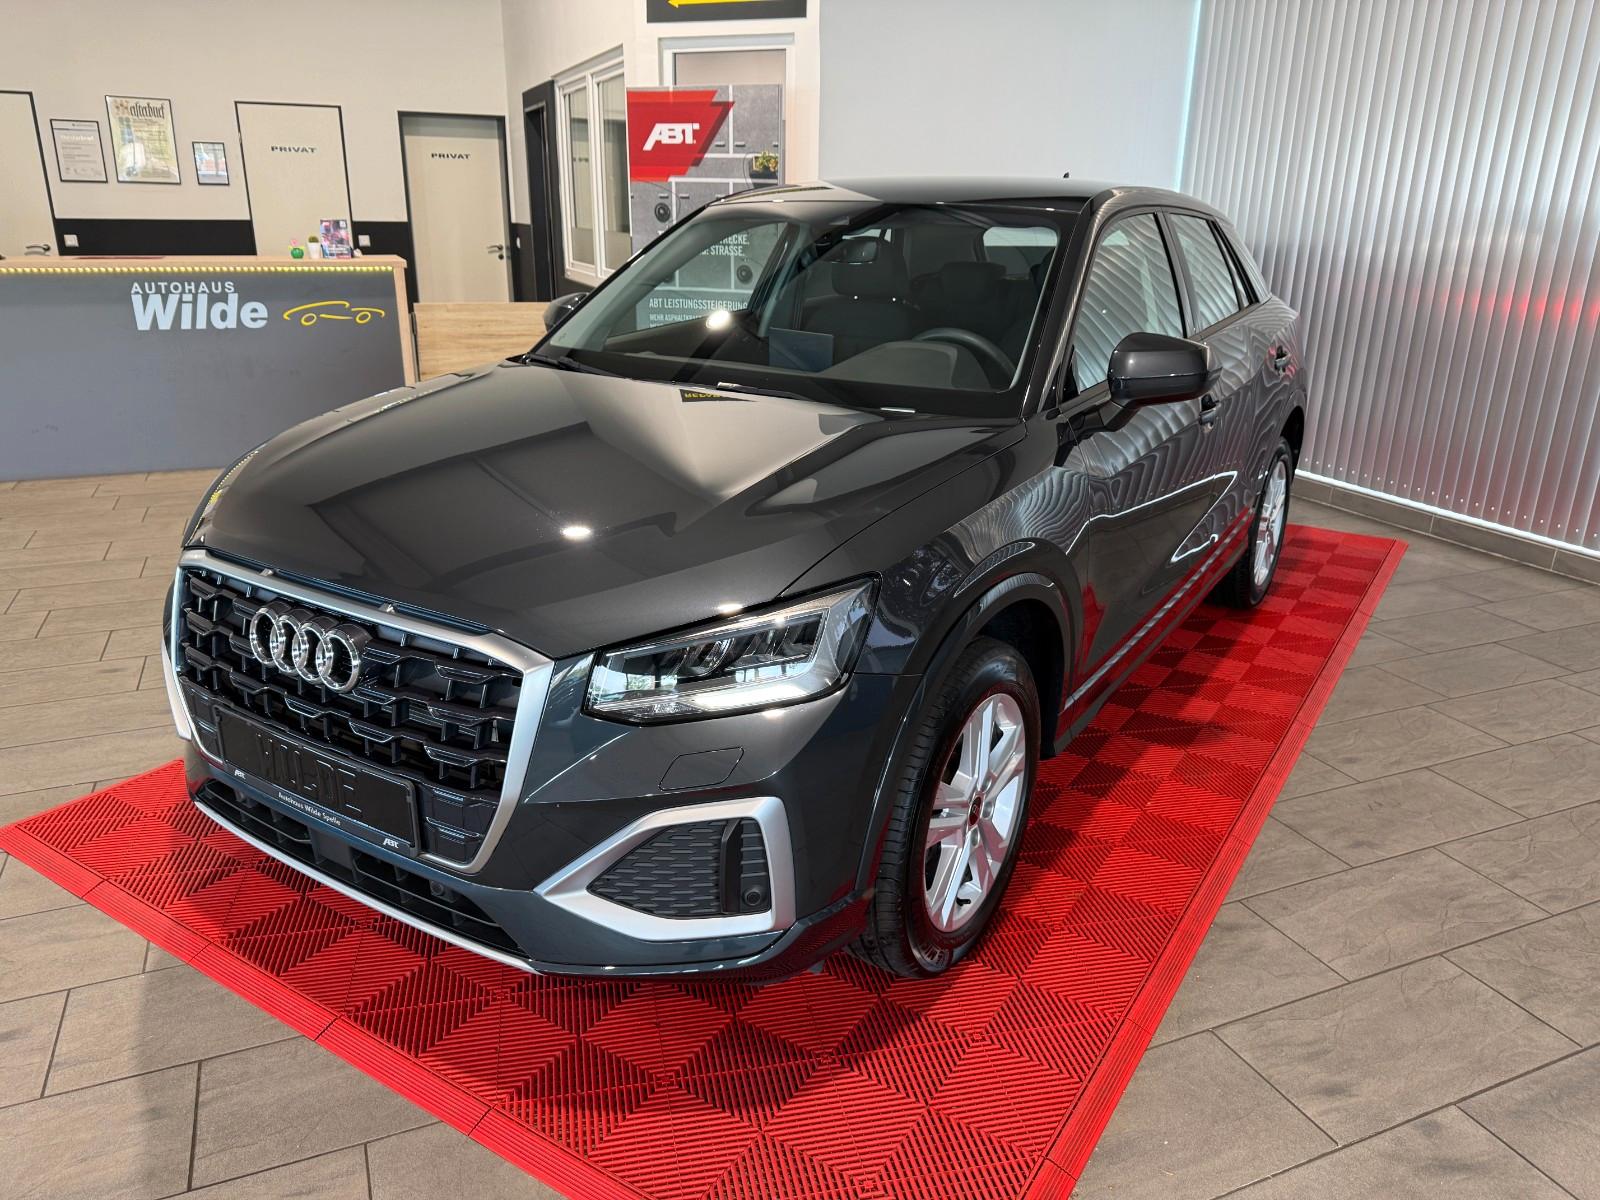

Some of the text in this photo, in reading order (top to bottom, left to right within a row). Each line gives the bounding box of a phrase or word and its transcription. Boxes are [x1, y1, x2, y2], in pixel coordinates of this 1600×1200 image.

[642, 122, 700, 151] ABT
[270, 145, 317, 153] PRIVAT
[431, 152, 471, 160] PRIVAT
[710, 244, 745, 257] STRASSE.
[130, 281, 235, 294] AUTOHAUS
[649, 298, 663, 309] ABT
[131, 293, 269, 331] Wilde
[304, 803, 321, 817] Wilde
[383, 837, 399, 848] ABT
